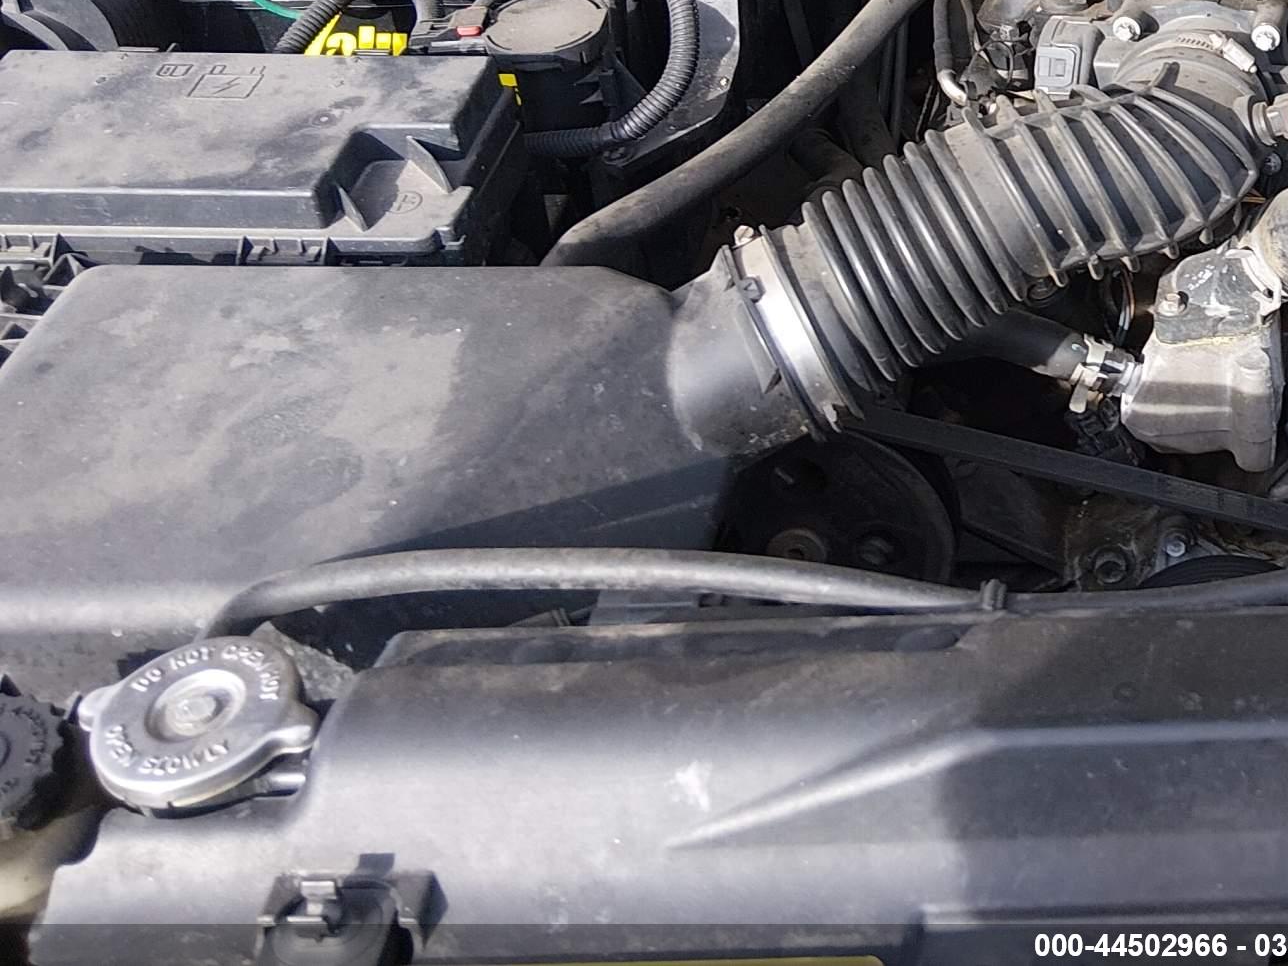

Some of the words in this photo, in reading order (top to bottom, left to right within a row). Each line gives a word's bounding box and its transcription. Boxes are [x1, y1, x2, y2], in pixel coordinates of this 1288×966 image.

[130, 668, 163, 693] DO
[168, 645, 215, 671] NOT
[104, 724, 137, 767] OPEN
[138, 739, 230, 776] SLOWLY
